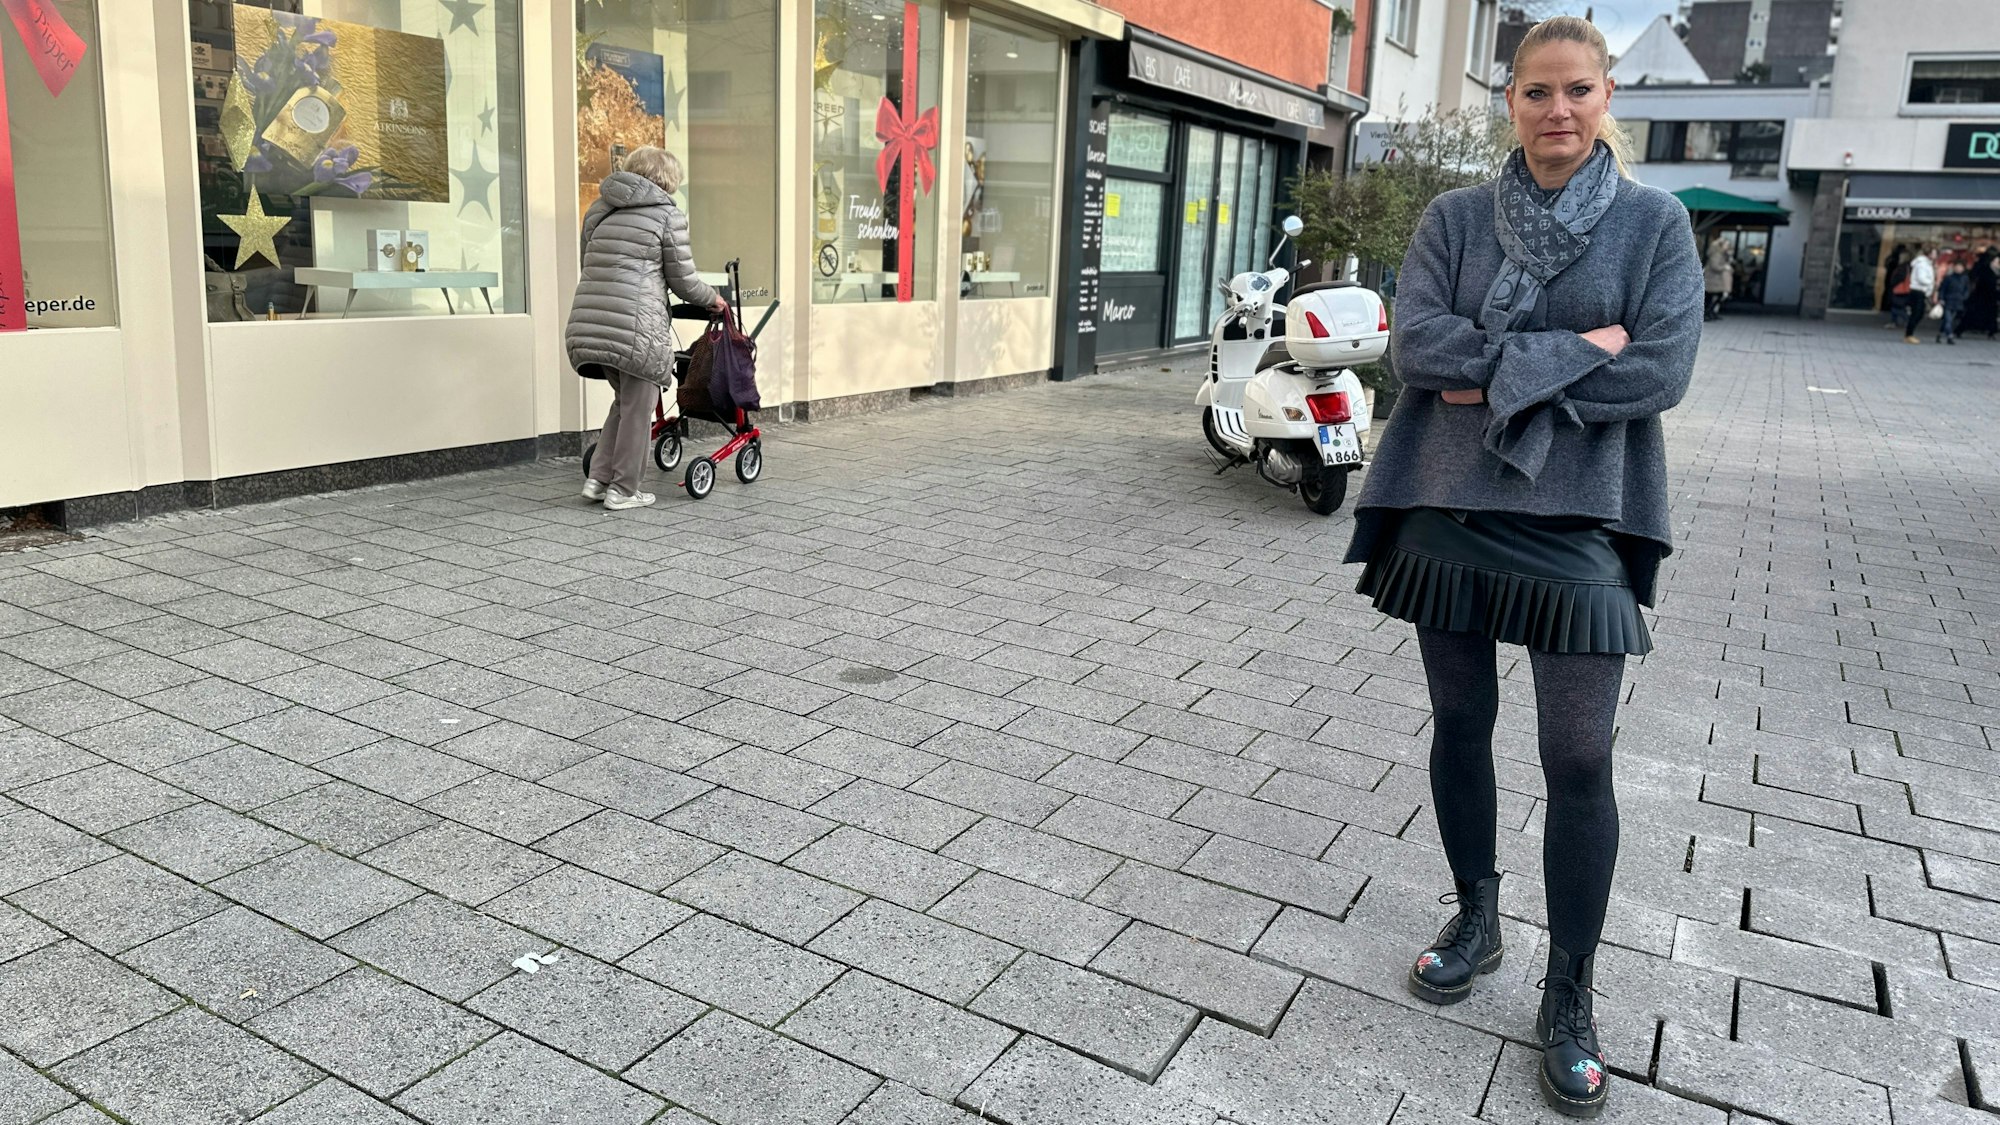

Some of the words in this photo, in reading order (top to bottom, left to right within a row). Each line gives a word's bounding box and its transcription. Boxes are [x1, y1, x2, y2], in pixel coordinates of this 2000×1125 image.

[373, 121, 427, 136] ATKINSONS
[848, 194, 881, 220] Freude
[1857, 207, 1912, 219] DOUGLAS
[857, 218, 900, 240] schenken
[25, 295, 96, 316] eper.de
[1103, 298, 1136, 322] Marco
[1334, 425, 1344, 437] K
[1335, 449, 1359, 463] 866
